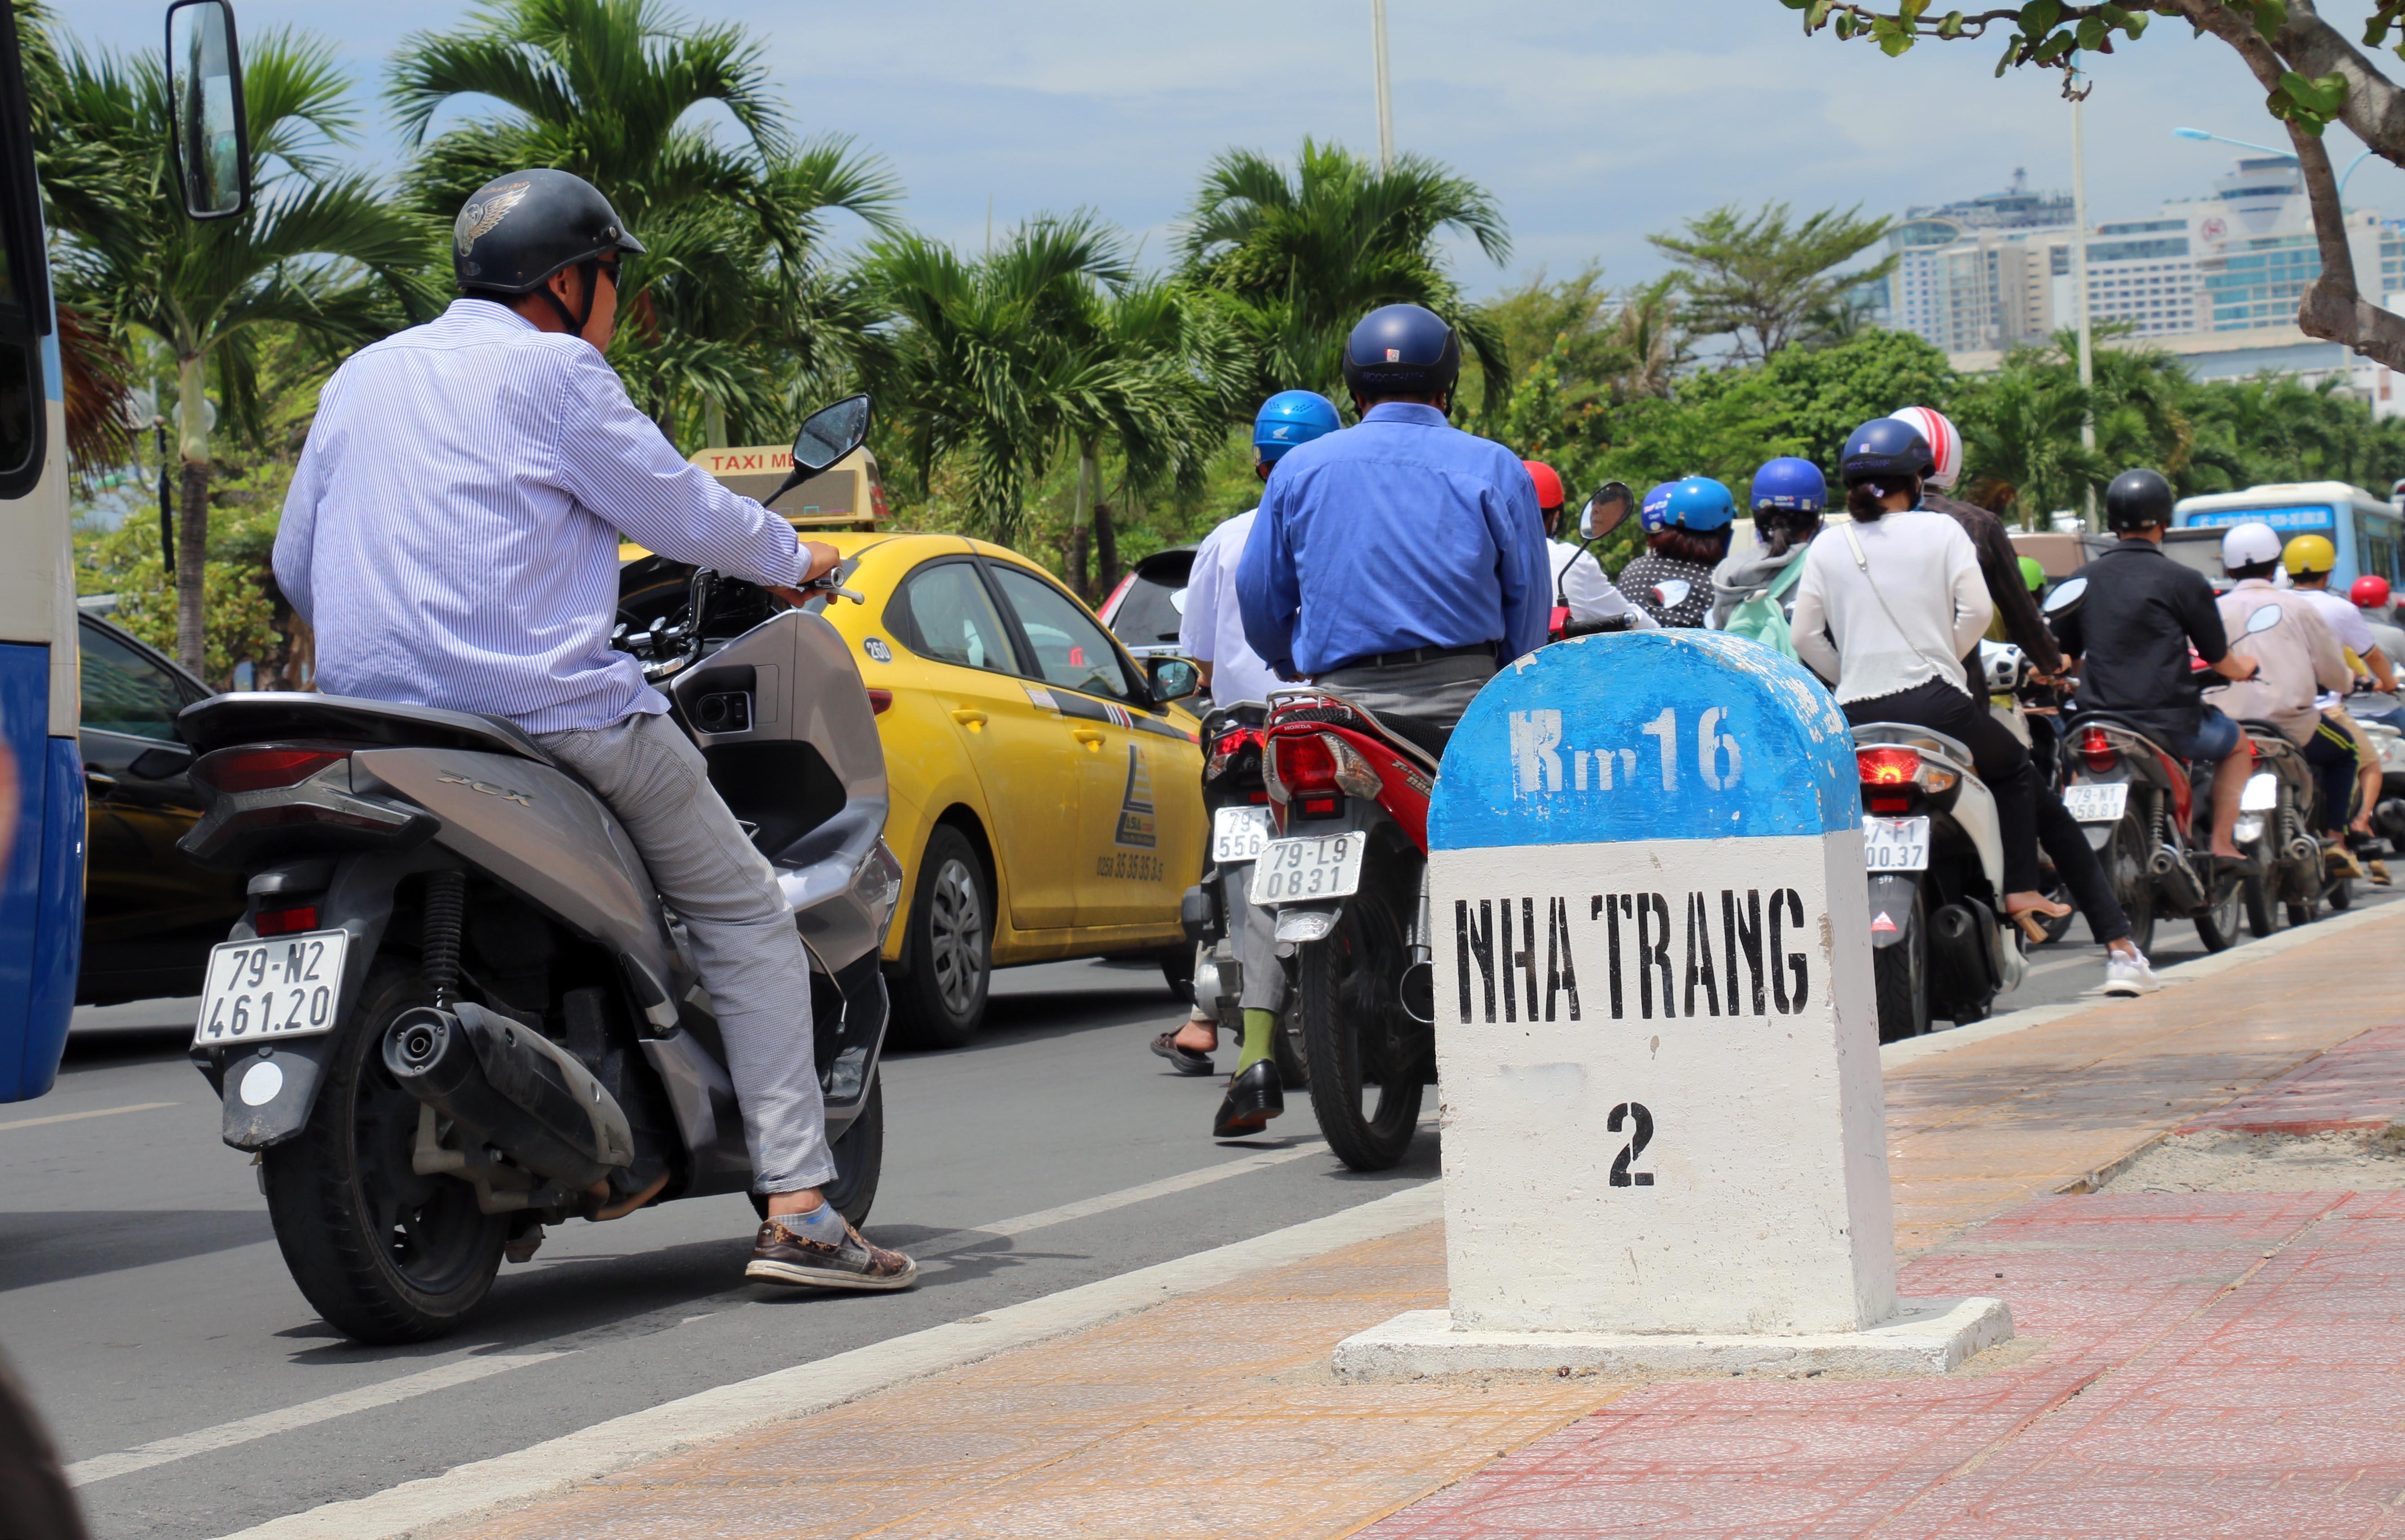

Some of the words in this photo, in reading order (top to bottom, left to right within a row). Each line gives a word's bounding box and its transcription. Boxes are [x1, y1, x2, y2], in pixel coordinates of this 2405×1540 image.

[711, 455, 762, 470] TAXI
[866, 642, 890, 659] 260
[435, 769, 536, 807] PCX
[2075, 787, 2115, 804] 79-N1
[1125, 817, 1141, 830] ASIA
[1229, 809, 1272, 832] 79-
[1865, 822, 1915, 843] 7-F1
[1220, 834, 1260, 858] 556
[1273, 838, 1347, 870] 79-L9
[1115, 853, 1126, 878] 35
[1127, 854, 1138, 879] 35
[1139, 855, 1150, 881] 35
[1267, 867, 1340, 898] 0831
[228, 941, 324, 991] 79-N2
[1455, 896, 1581, 1024] NHA
[1591, 888, 1808, 1019] TRANG
[208, 986, 331, 1038] 461.20
[1607, 1102, 1654, 1187] 2
